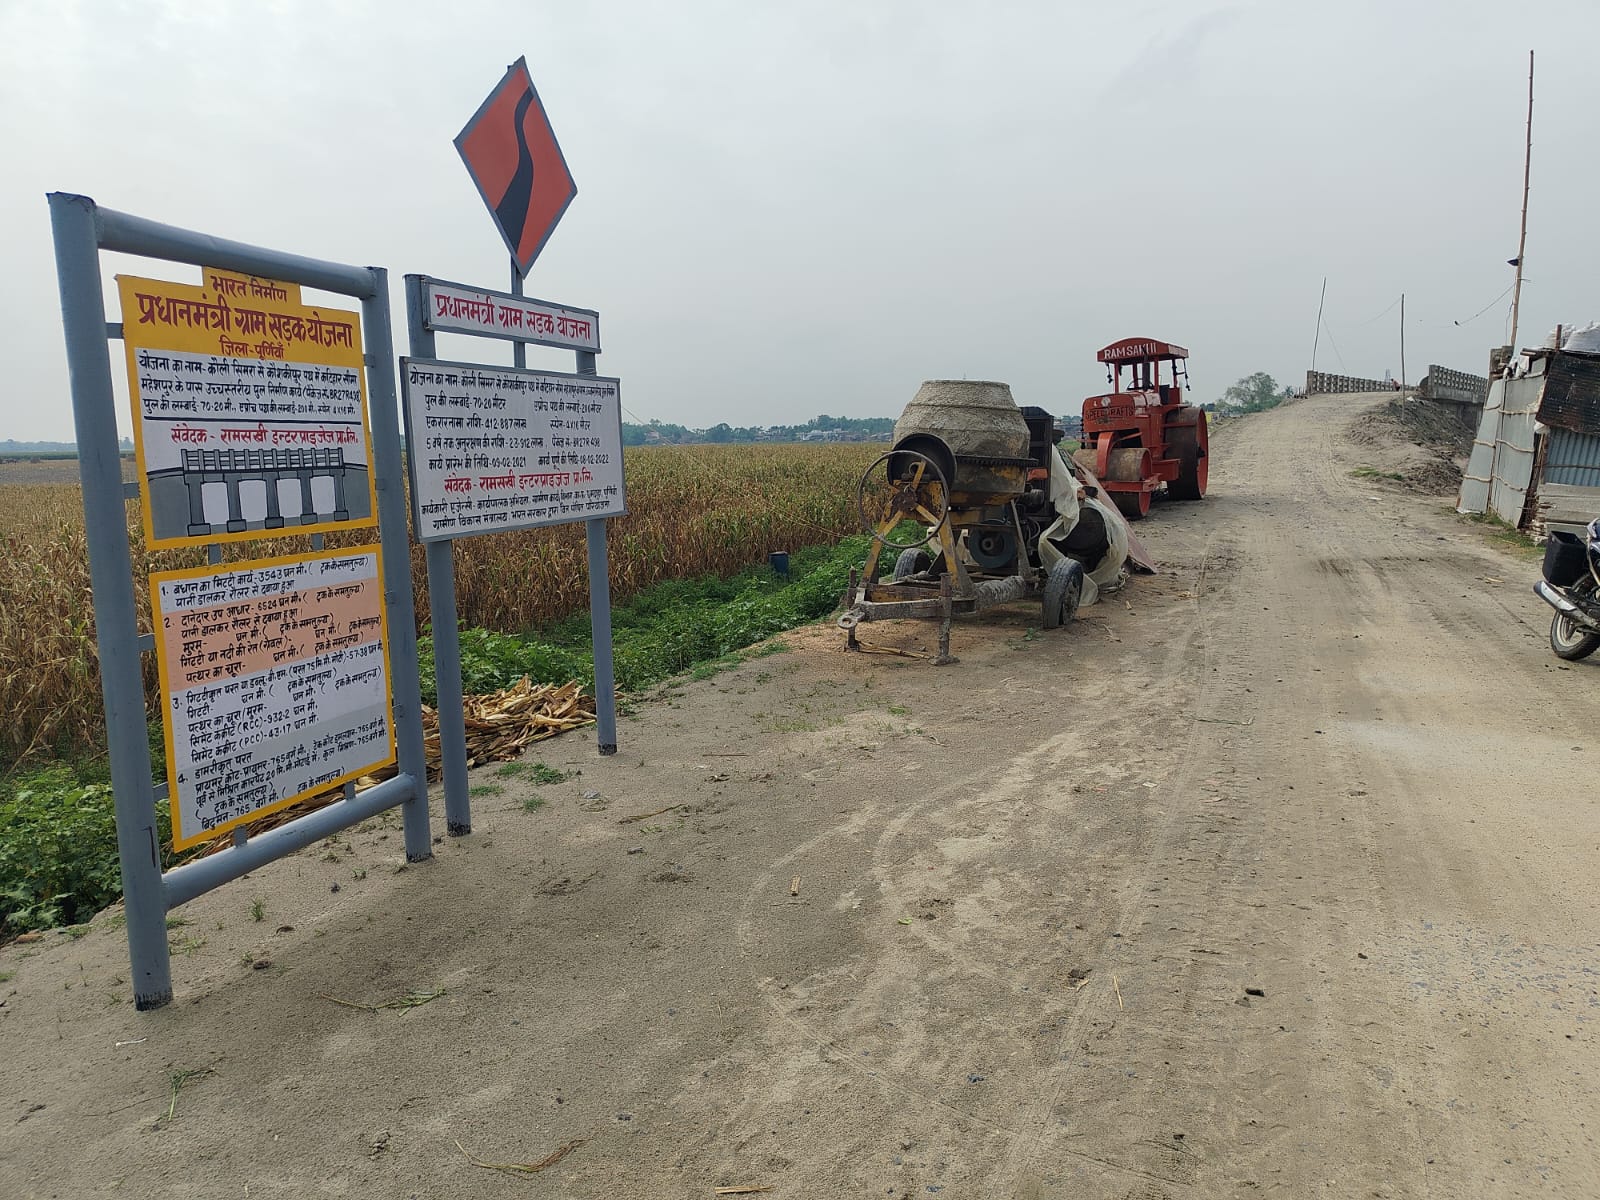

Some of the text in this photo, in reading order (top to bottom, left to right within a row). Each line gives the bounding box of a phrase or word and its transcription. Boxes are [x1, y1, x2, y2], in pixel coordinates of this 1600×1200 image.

[210, 276, 287, 302] भारत निर्माण
[135, 293, 352, 348] प्रधानमंत्री ग्राम सड़क योजना
[435, 295, 590, 340] प्रधानमंत्री ग्राम सड़क योजना
[139, 350, 169, 371] योजना
[231, 359, 255, 376] सिमरा
[141, 374, 173, 396] महेशपुर
[410, 366, 433, 385] योजना
[143, 399, 159, 414] पुल
[218, 421, 268, 444] रामसखी
[479, 469, 515, 490] रामसखी
[176, 593, 196, 607] पानी
[198, 591, 226, 605] डालकर
[181, 610, 209, 627] दानेदार
[258, 600, 277, 611] 6524
[181, 624, 198, 638] पानी
[202, 622, 229, 636] डालकर
[220, 643, 234, 660] नदी
[235, 752, 253, 765] परत
